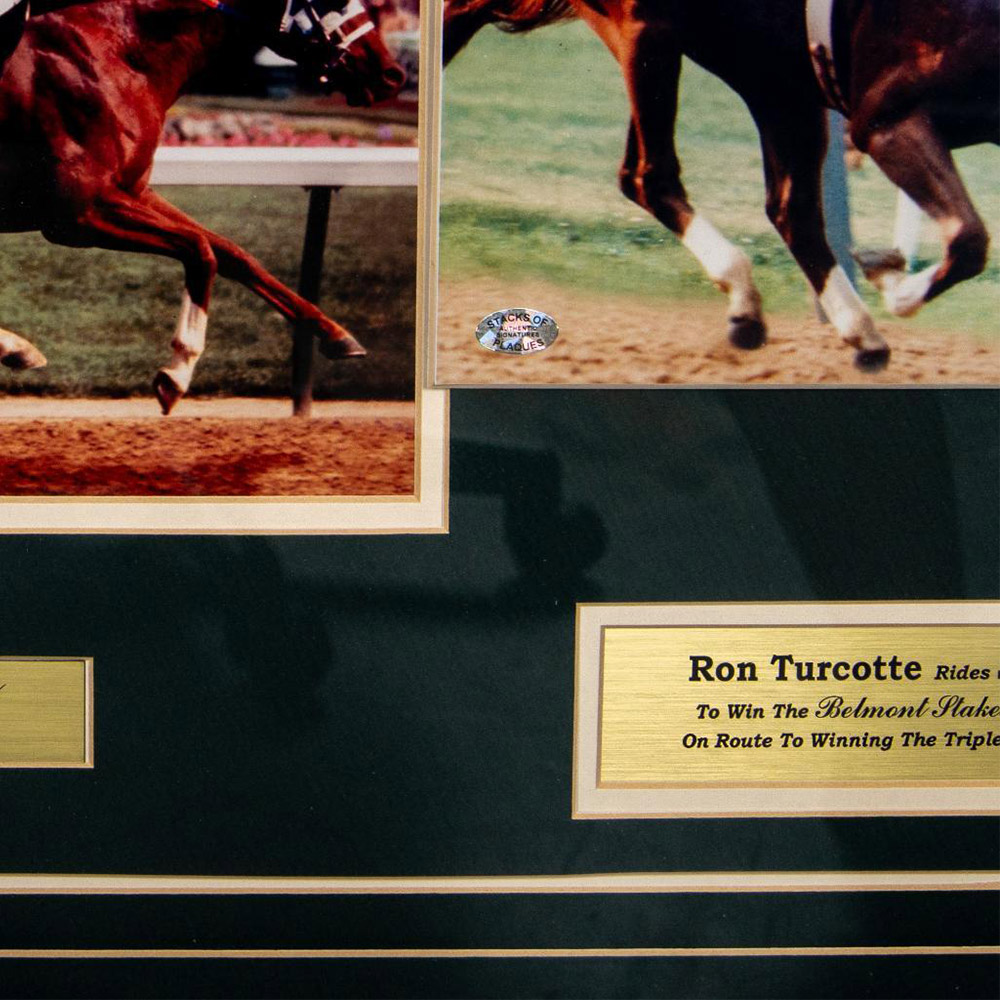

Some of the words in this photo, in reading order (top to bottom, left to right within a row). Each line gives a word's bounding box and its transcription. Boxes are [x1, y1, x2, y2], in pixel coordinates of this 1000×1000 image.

[487, 313, 530, 329] STACKS
[533, 315, 548, 326] OF
[493, 338, 545, 351] PLAQUES
[688, 655, 758, 682] Ron
[770, 654, 922, 681] Turcotte
[933, 664, 991, 680] Rides
[696, 703, 720, 719] To
[727, 703, 765, 719] Win
[772, 703, 809, 719] The
[814, 694, 930, 719] Belmont
[682, 733, 709, 749] On
[714, 733, 773, 749] Route
[779, 732, 804, 748] To
[811, 731, 893, 751] Winning
[901, 731, 937, 748] The
